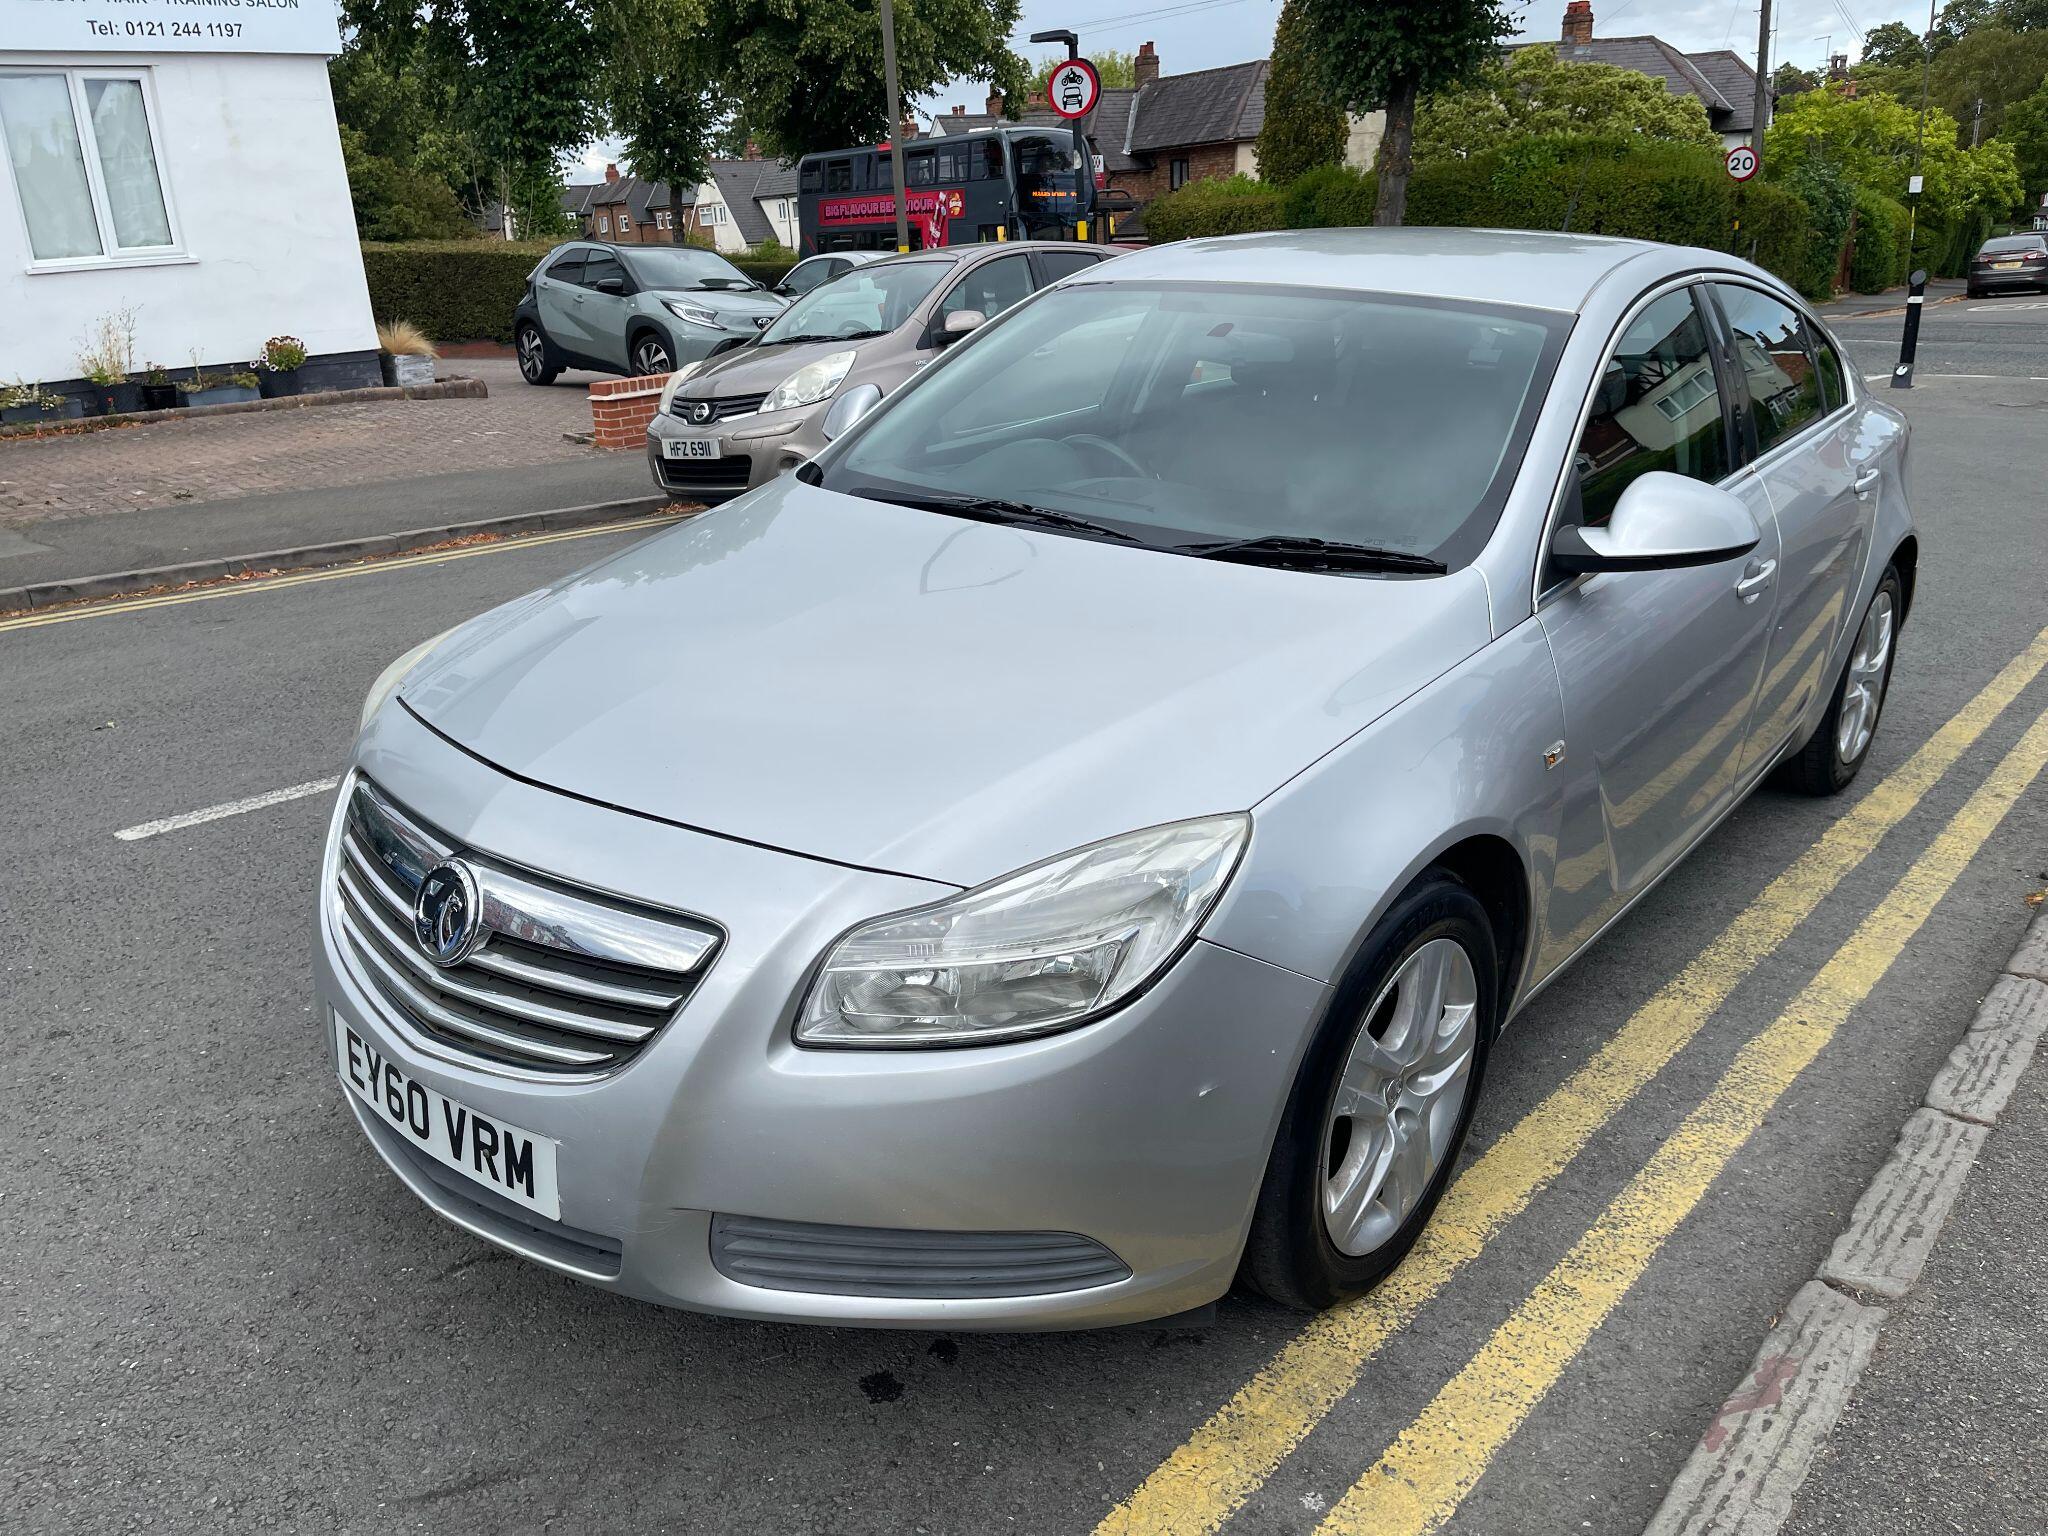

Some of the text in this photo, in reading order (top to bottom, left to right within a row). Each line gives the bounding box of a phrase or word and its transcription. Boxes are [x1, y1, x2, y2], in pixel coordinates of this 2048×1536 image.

[86, 20, 242, 38] Tel: 0121 244 1197
[1730, 156, 1754, 171] 20
[825, 205, 839, 217] BIG
[840, 201, 879, 216] FLAVOUR
[880, 198, 934, 215] BEHVIOUR
[669, 441, 712, 457] HFZ 6911
[346, 1026, 535, 1199] EY60 VRM
